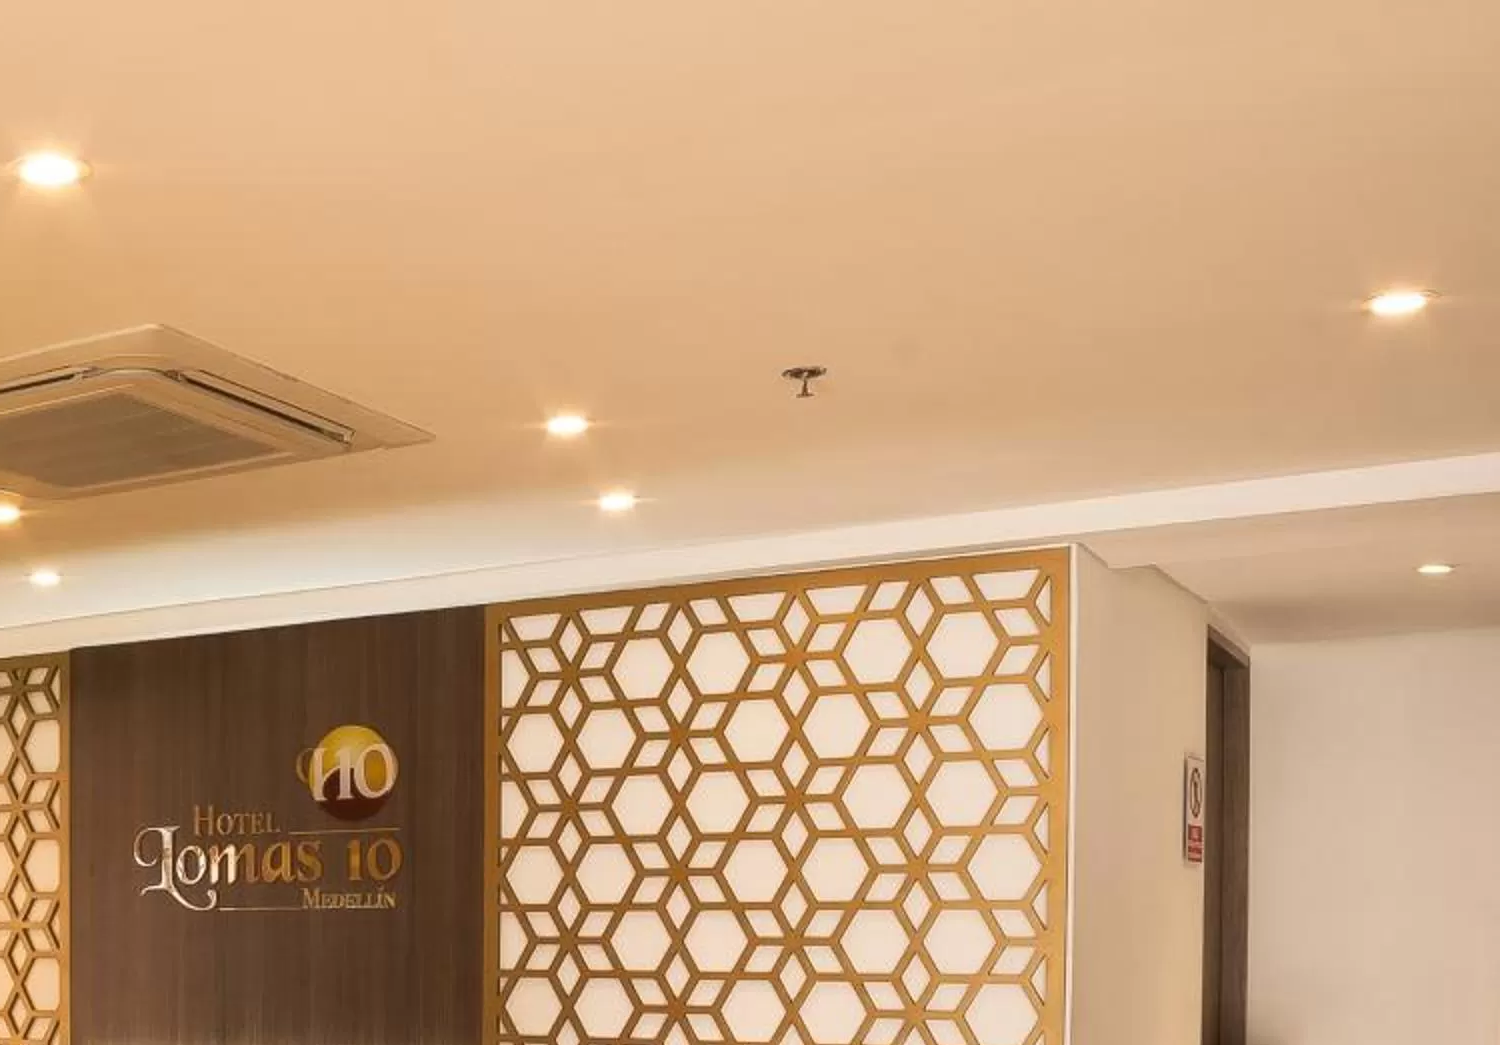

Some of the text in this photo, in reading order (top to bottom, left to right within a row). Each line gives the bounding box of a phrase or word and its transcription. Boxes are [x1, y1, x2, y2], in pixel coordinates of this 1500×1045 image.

[193, 804, 281, 836] HOTEL
[133, 825, 404, 911] Lomas 10
